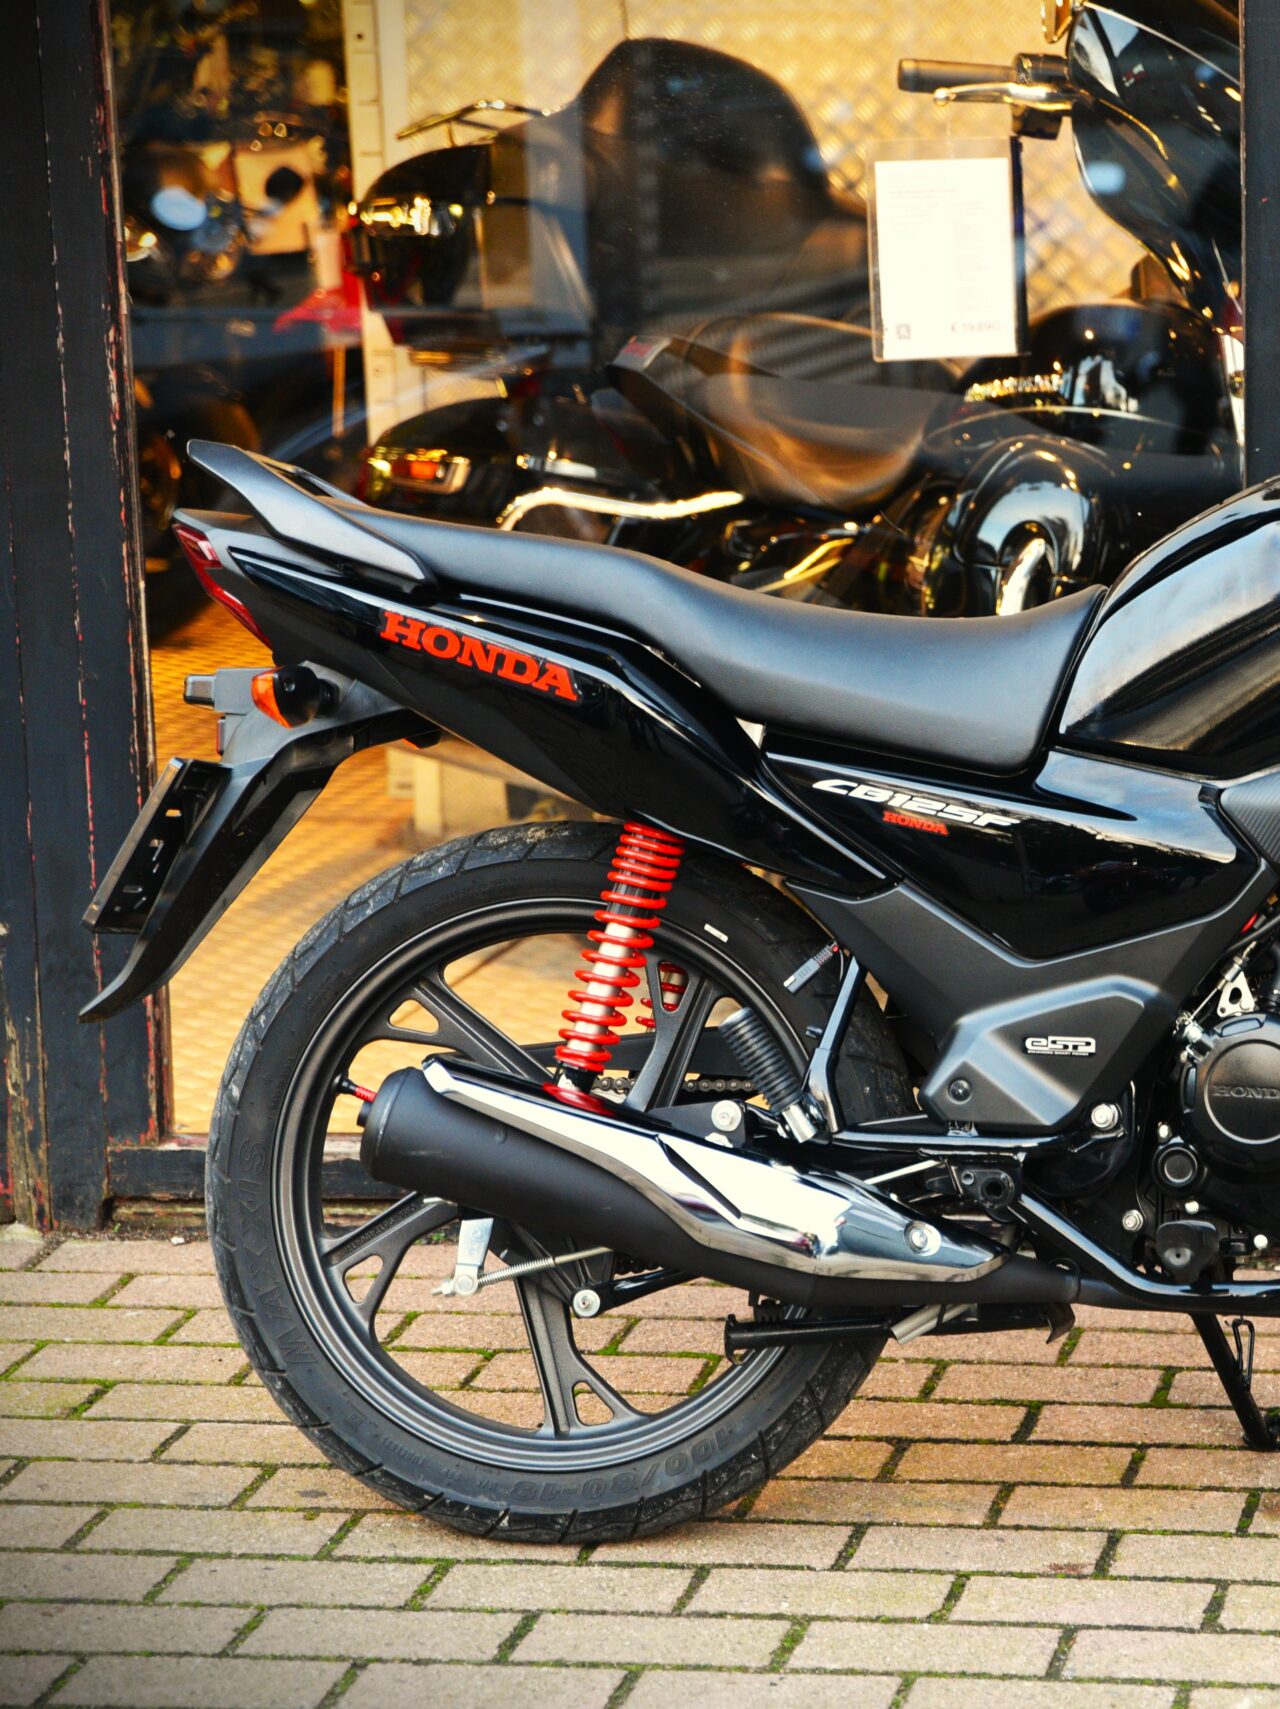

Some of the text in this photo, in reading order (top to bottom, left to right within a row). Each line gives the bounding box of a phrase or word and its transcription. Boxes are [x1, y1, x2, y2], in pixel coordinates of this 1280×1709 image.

[379, 610, 578, 702] HONDA
[812, 779, 1021, 827] CB125F
[882, 810, 949, 836] HONDA
[237, 1137, 320, 1365] MAXXIS
